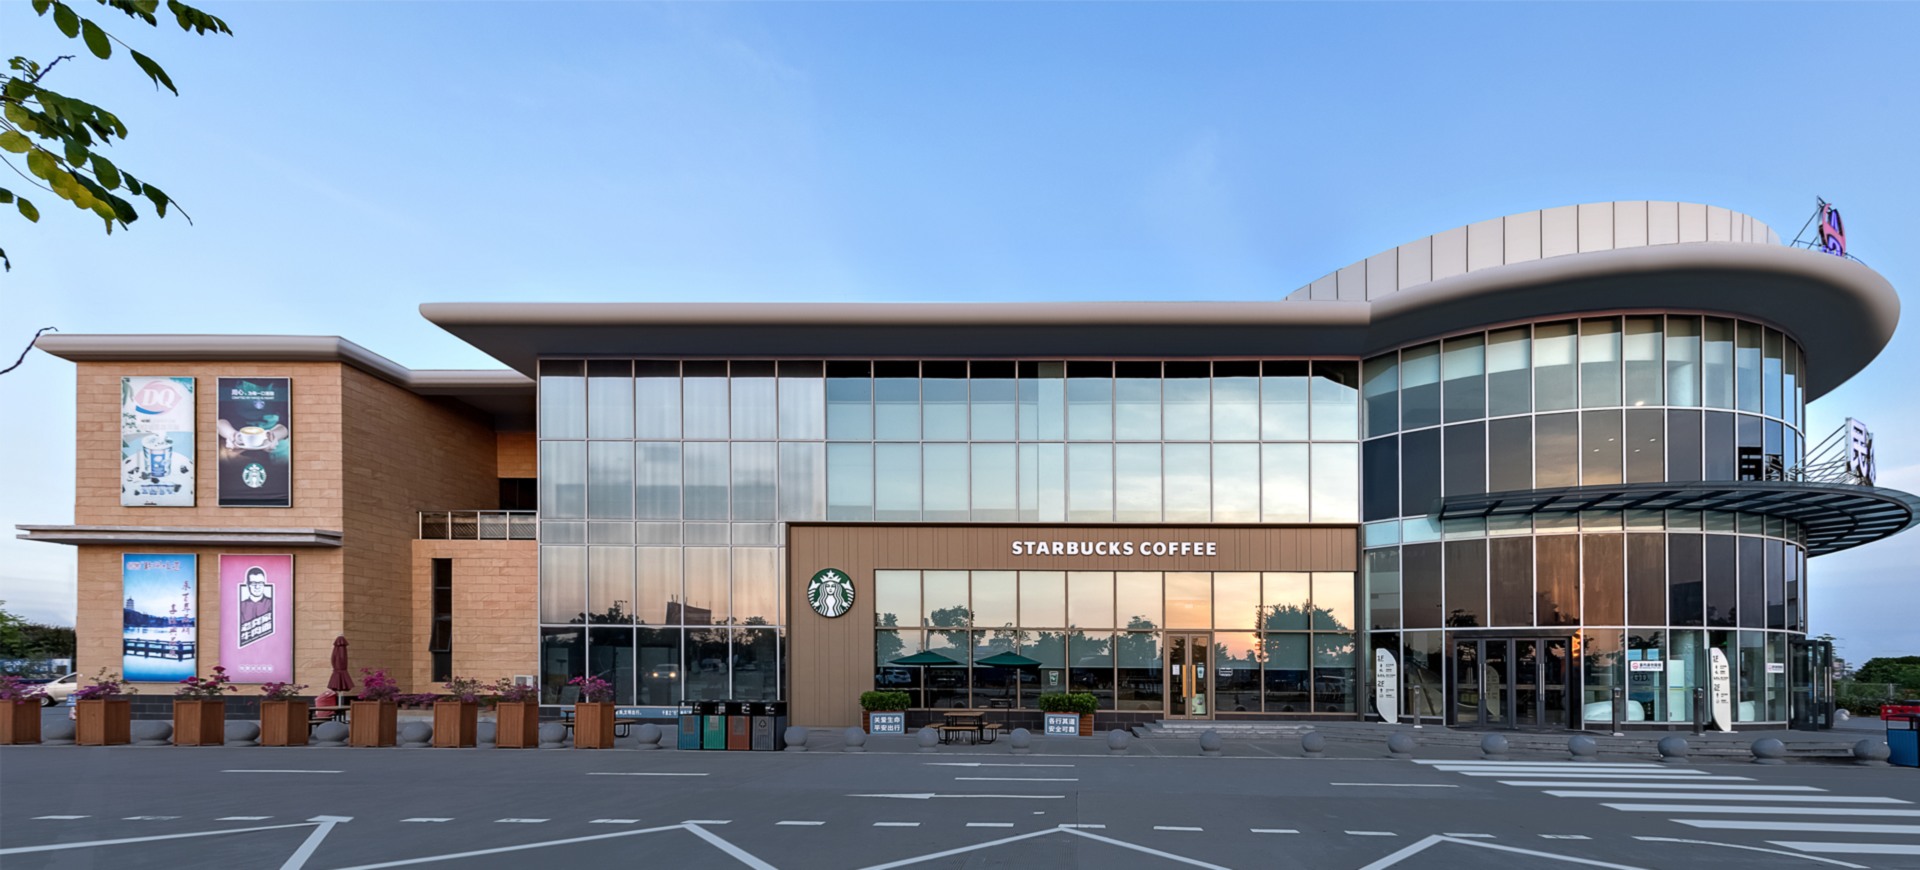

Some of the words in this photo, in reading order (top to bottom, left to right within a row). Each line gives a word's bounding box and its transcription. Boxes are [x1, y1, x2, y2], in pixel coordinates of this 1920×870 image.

[143, 389, 175, 408] DQ
[1011, 540, 1134, 556] STARBUCKS
[1140, 541, 1217, 556] COFFEE
[873, 716, 901, 724] 关爱生命
[1048, 717, 1076, 725] 各行其道
[873, 724, 901, 732] 平安出行
[1048, 725, 1076, 733] 安全可靠
